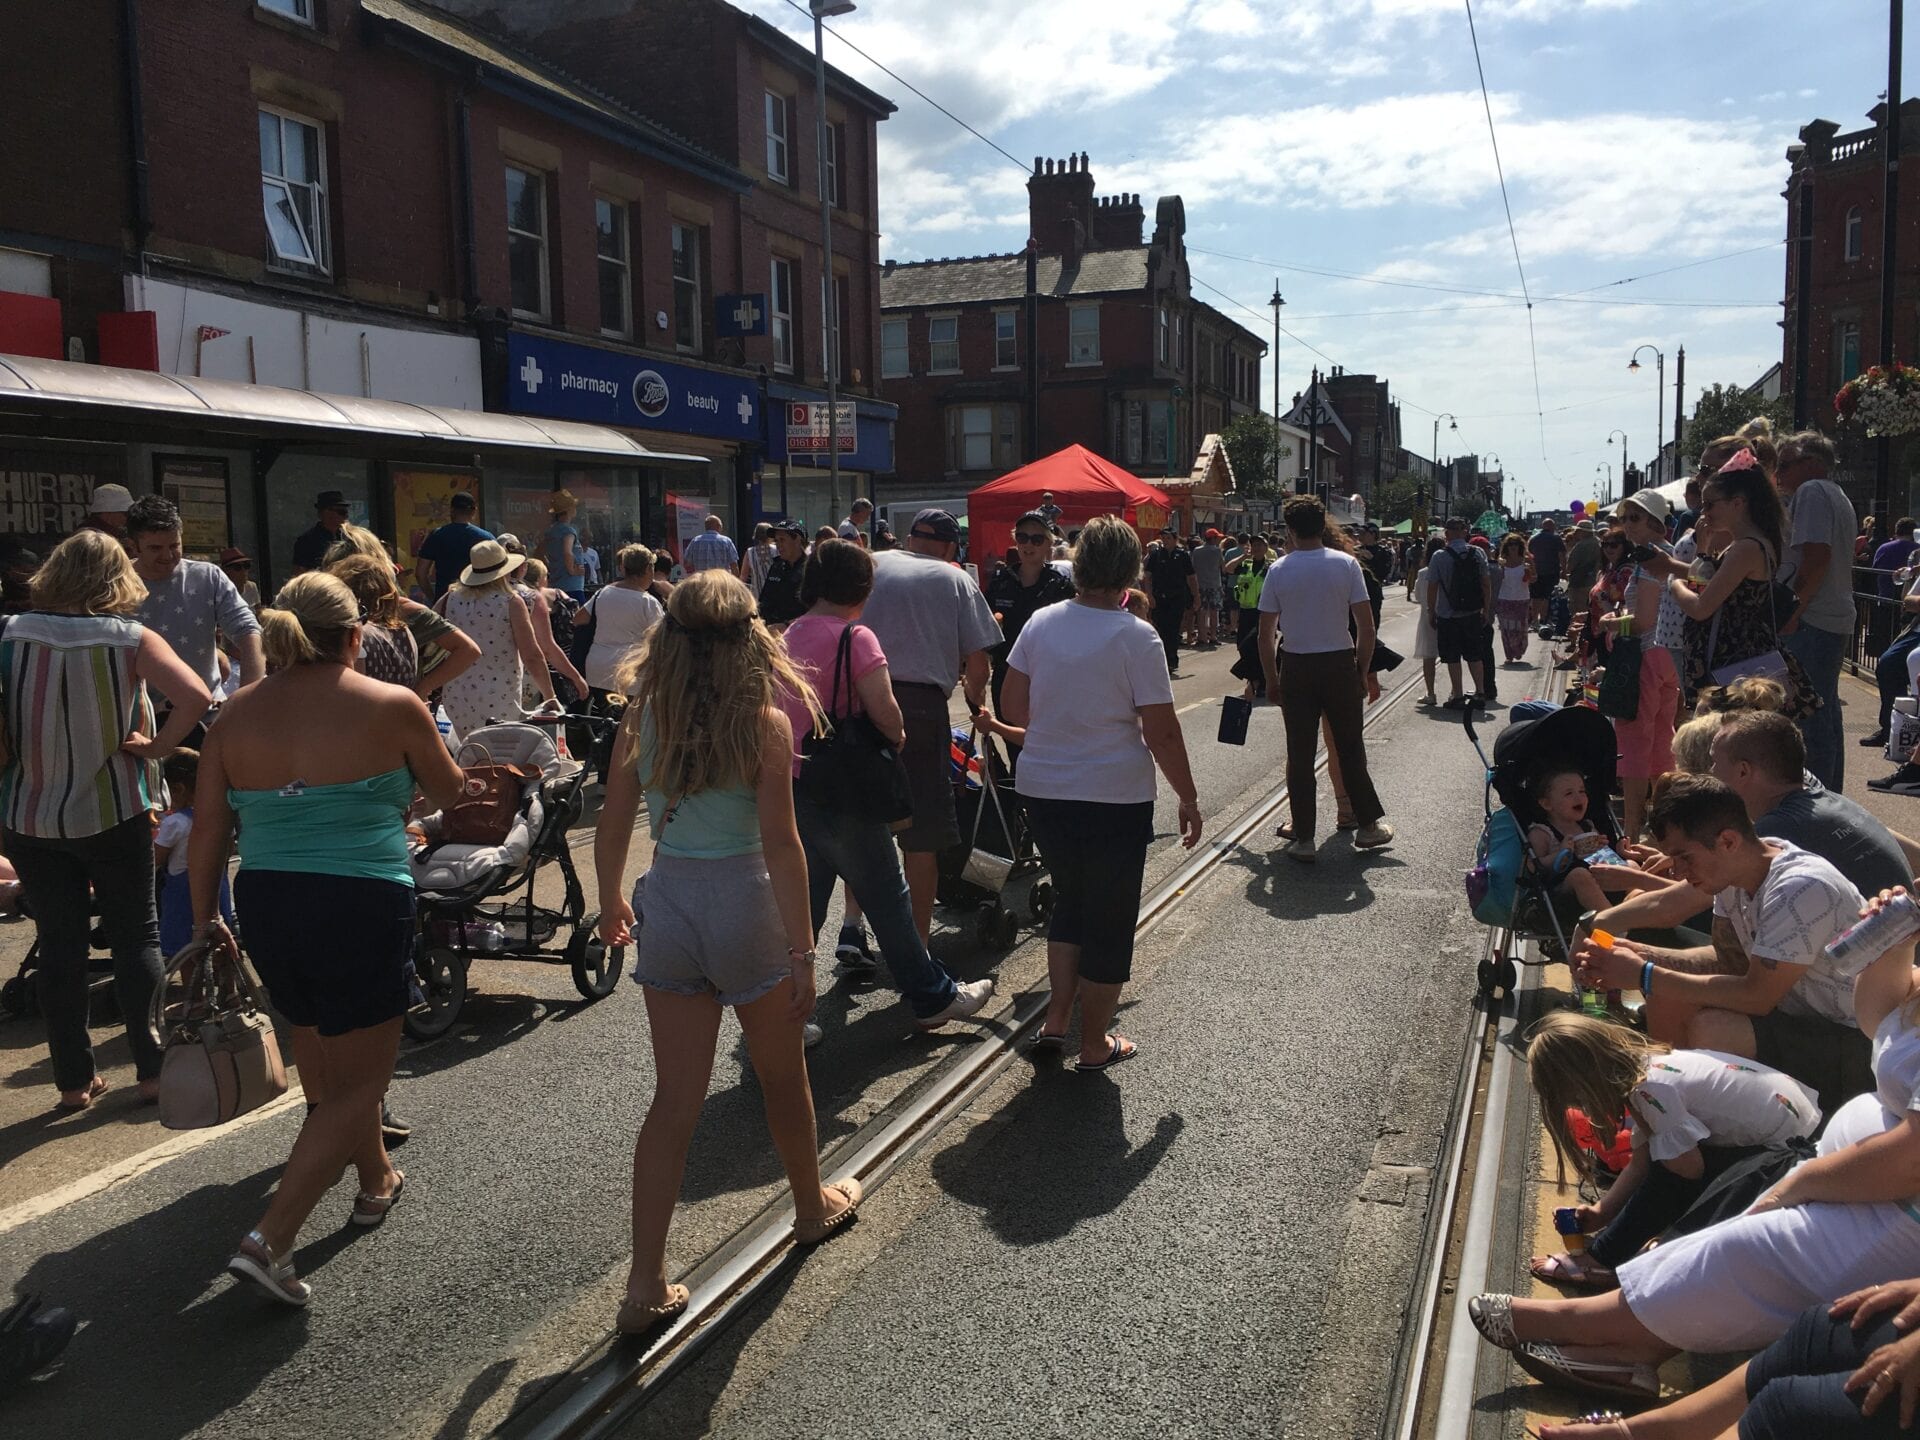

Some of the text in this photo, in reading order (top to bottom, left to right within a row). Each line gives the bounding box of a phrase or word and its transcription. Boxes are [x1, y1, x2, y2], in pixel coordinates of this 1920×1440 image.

[561, 370, 619, 398] pharmacy
[641, 381, 665, 404] Boots
[687, 391, 720, 414] beauty
[814, 411, 852, 419] Avable
[787, 426, 854, 437] barkerprolove
[790, 438, 808, 447] 0161
[812, 437, 828, 447] 631
[0, 471, 96, 503] HURRY
[506, 497, 531, 512] from
[1831, 826, 1855, 840] The
